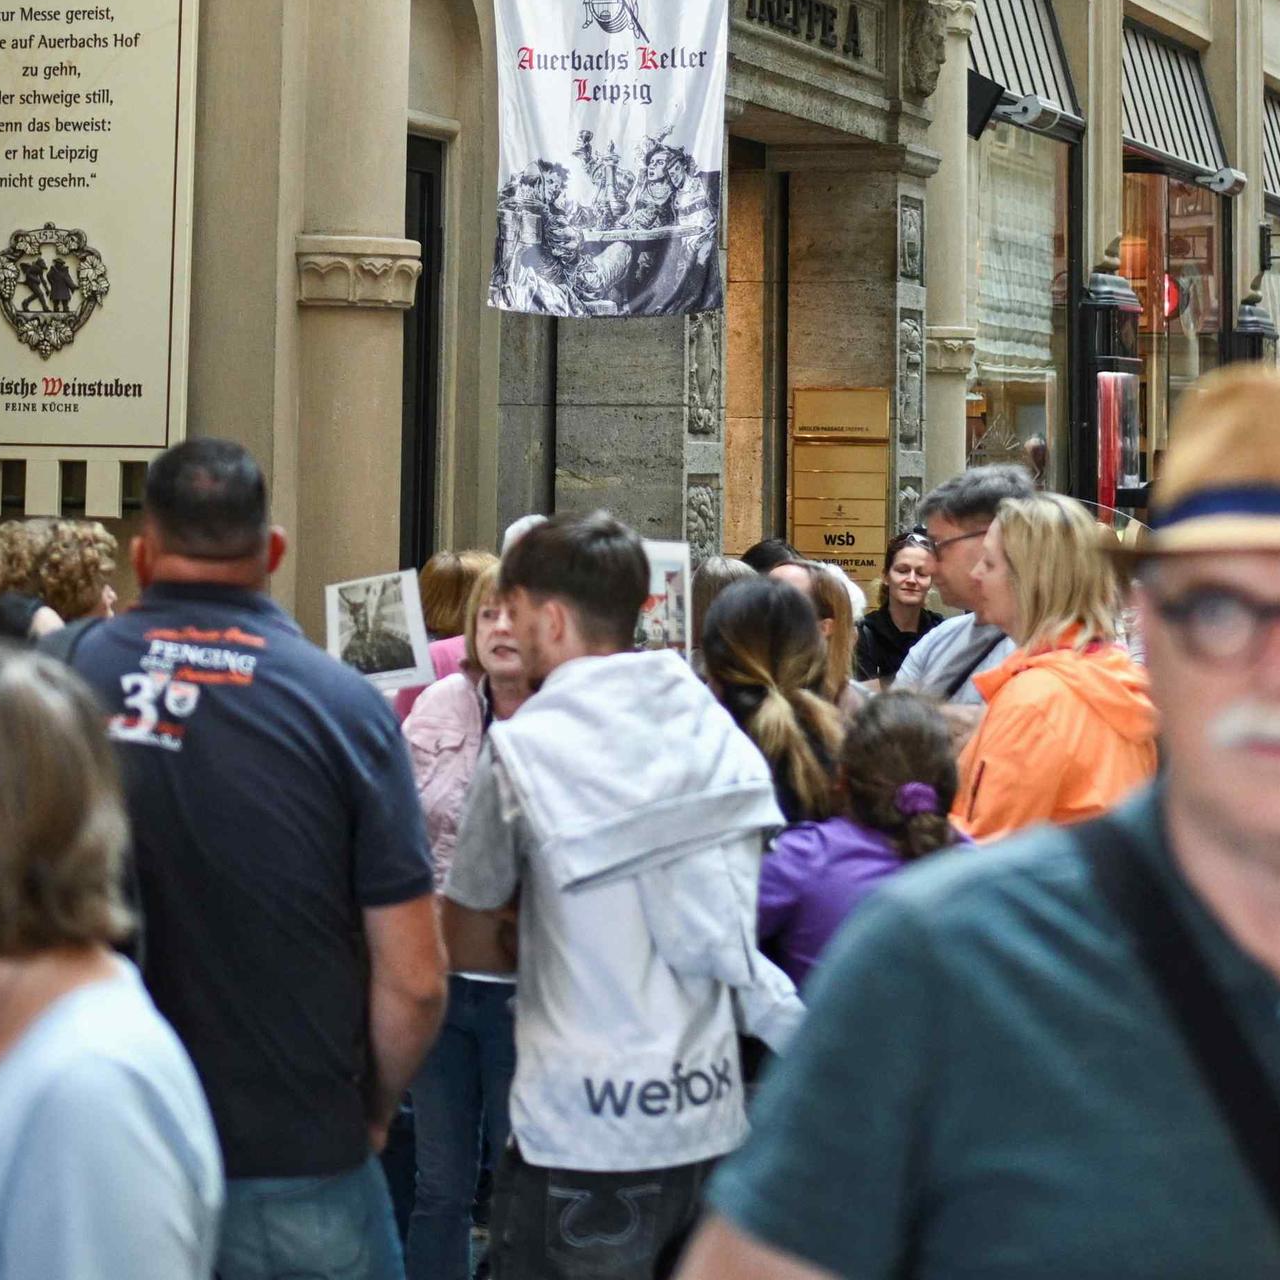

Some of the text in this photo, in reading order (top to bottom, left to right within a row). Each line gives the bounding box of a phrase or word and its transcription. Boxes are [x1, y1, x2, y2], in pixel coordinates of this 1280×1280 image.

[20, 7, 61, 22] Messe
[65, 6, 115, 25] gereist,
[842, 3, 863, 55] A
[10, 32, 35, 50] auf
[37, 32, 109, 50] Auerbachs
[113, 31, 141, 49] Hof
[517, 45, 708, 73] Auerbachs Keller
[22, 61, 81, 81] zu gehn,
[19, 89, 81, 109] schweige
[84, 88, 114, 108] still,
[572, 78, 653, 105] Leipzig
[27, 116, 50, 133] das
[54, 116, 112, 134] beweist:
[4, 144, 99, 164] er hat Leipzig
[41, 376, 143, 399] Weinstuben
[5, 399, 79, 413] FEINE KÜCHE
[824, 531, 856, 547] wsb
[584, 1058, 732, 1118] wefox
